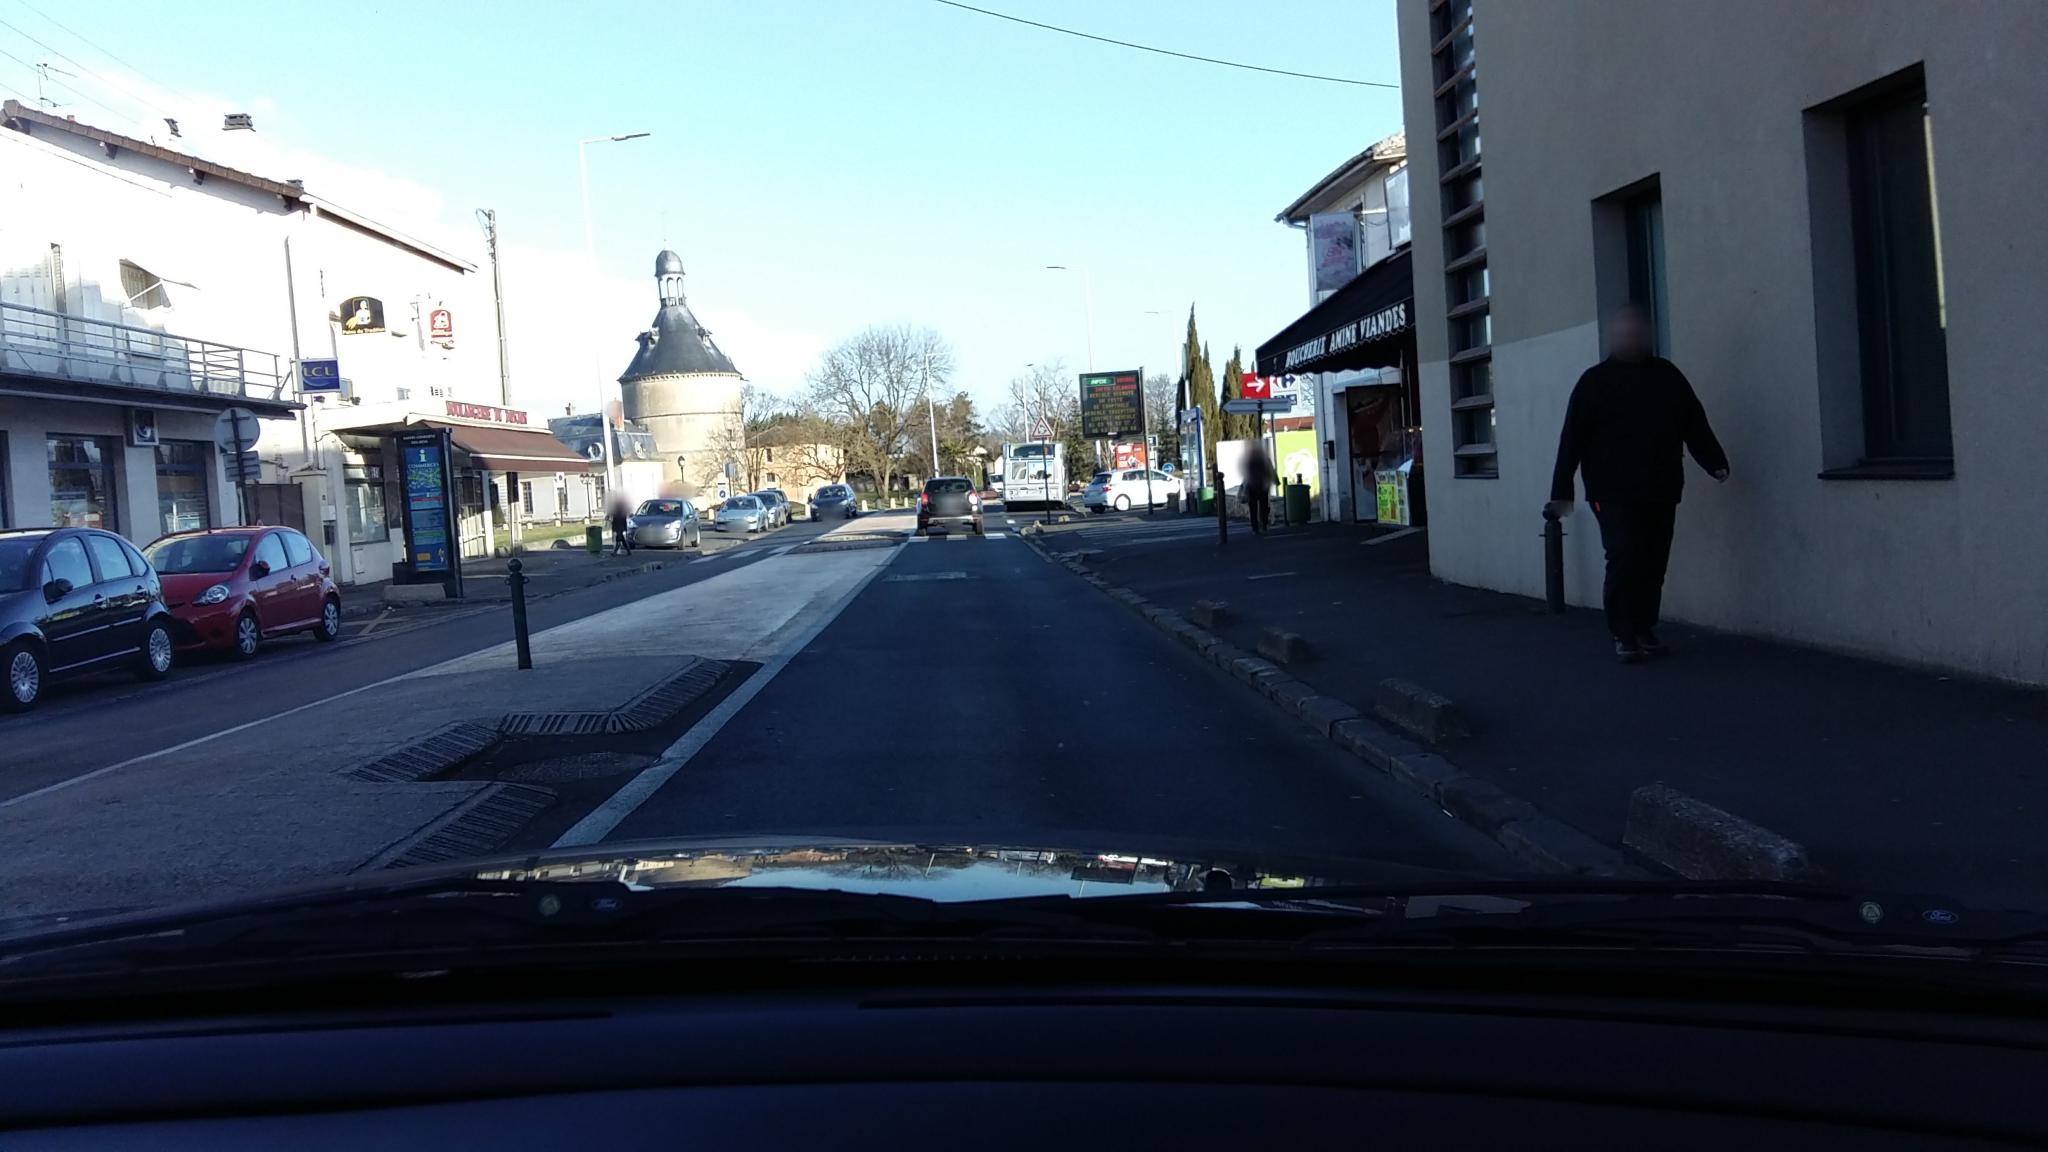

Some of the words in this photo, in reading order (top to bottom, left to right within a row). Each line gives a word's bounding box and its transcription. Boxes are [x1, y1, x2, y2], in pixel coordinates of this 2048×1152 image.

[1285, 336, 1327, 368] BOUCHERIE
[1329, 323, 1357, 353] AMINE
[1360, 303, 1406, 339] VIANDES
[303, 366, 335, 377] LCL
